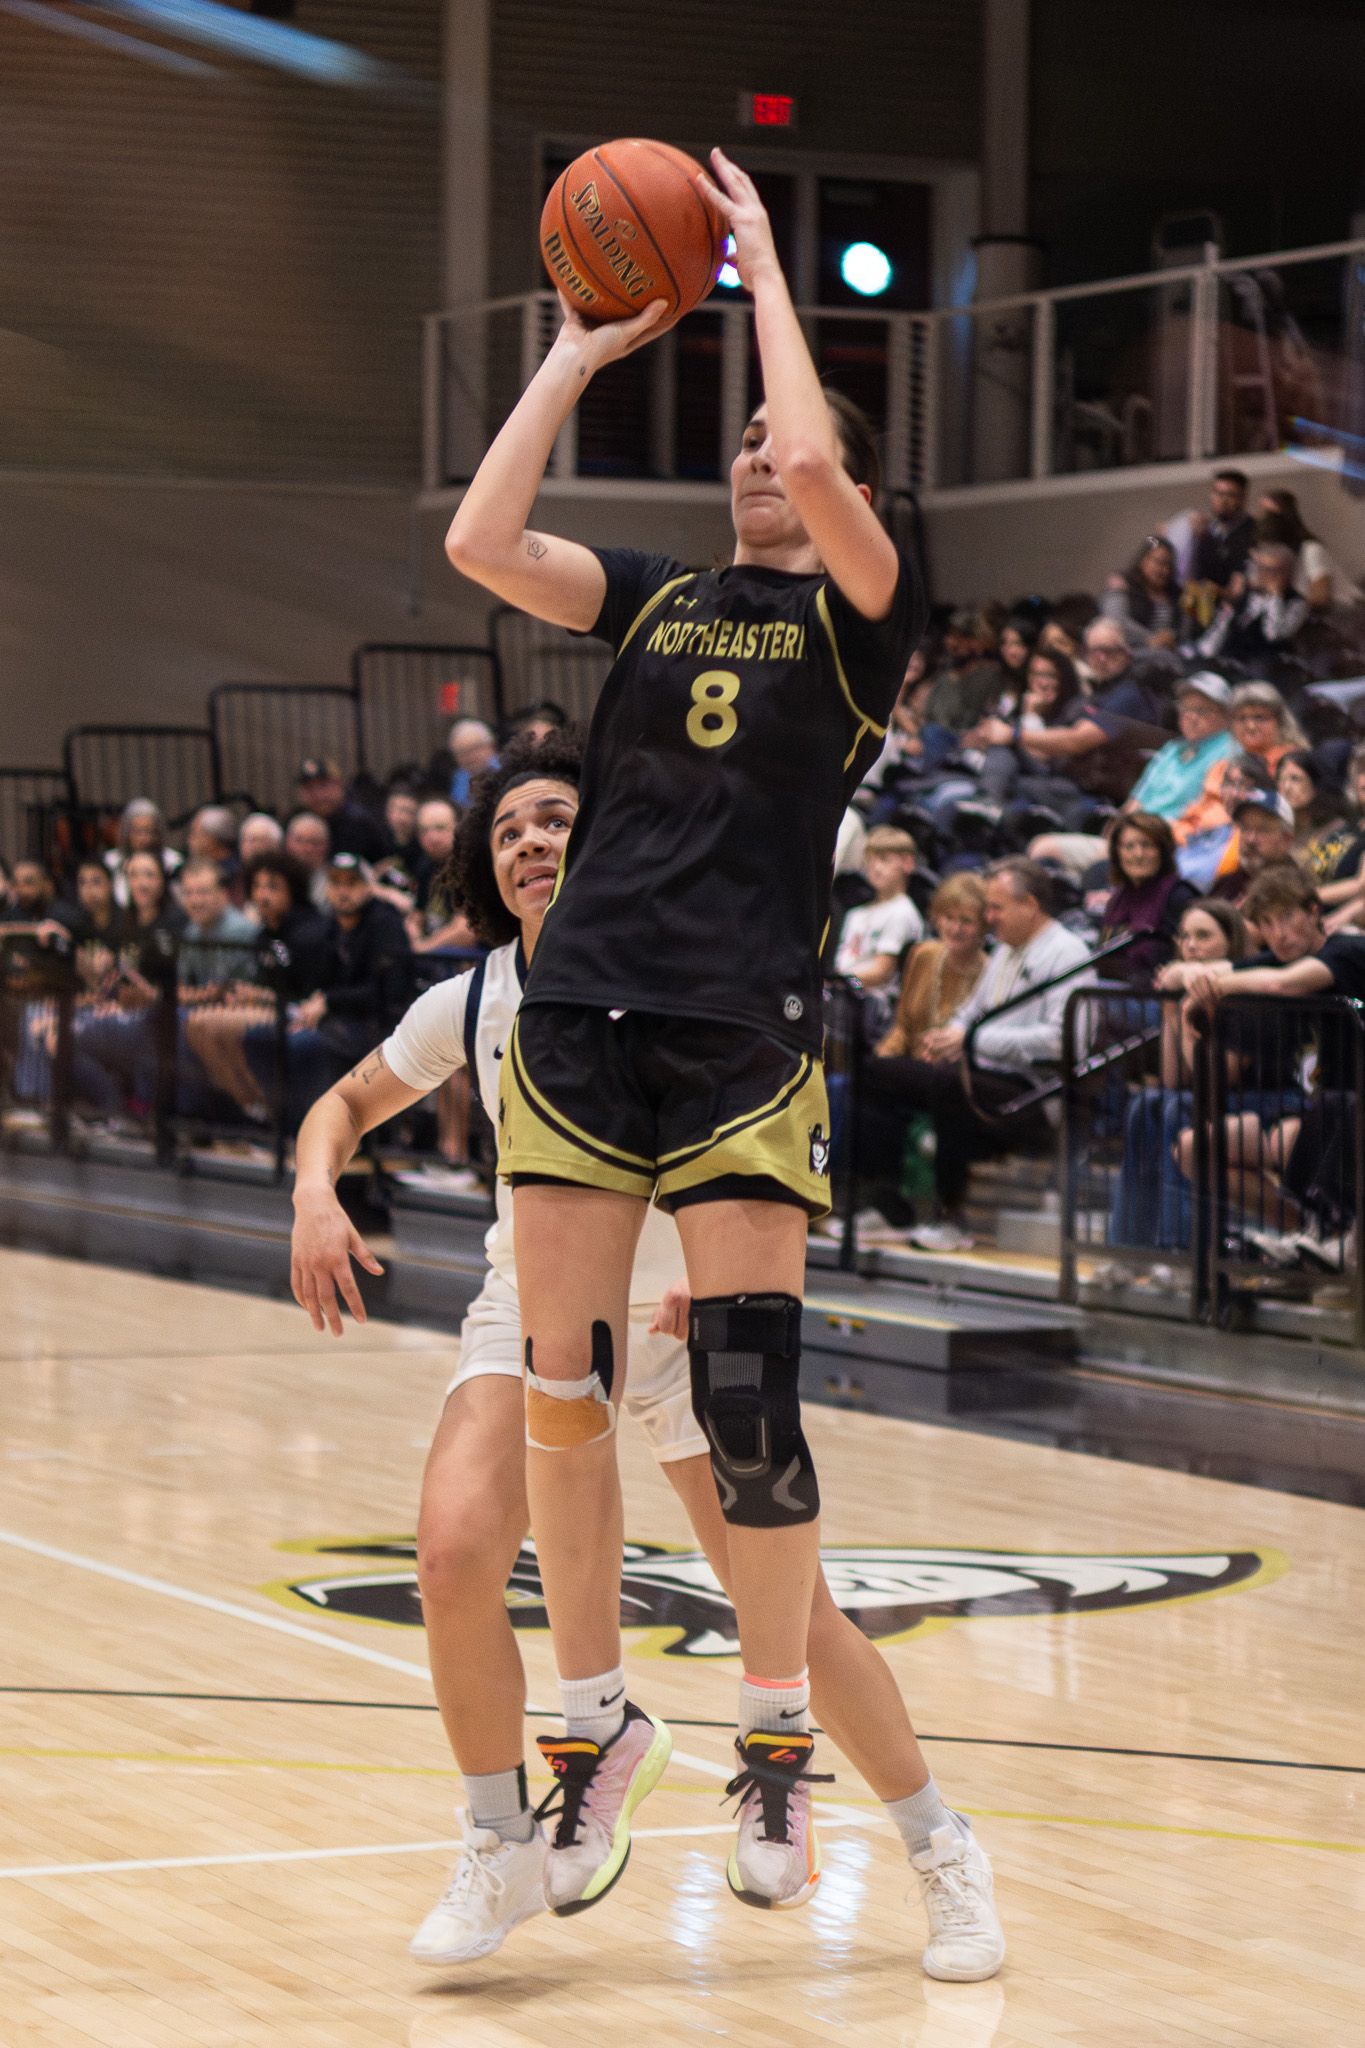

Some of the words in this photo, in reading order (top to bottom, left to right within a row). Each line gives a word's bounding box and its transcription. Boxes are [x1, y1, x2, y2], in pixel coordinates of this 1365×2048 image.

[570, 180, 654, 299] SPALDING
[645, 618, 808, 660] NORTHEASTER
[686, 669, 741, 748] 8
